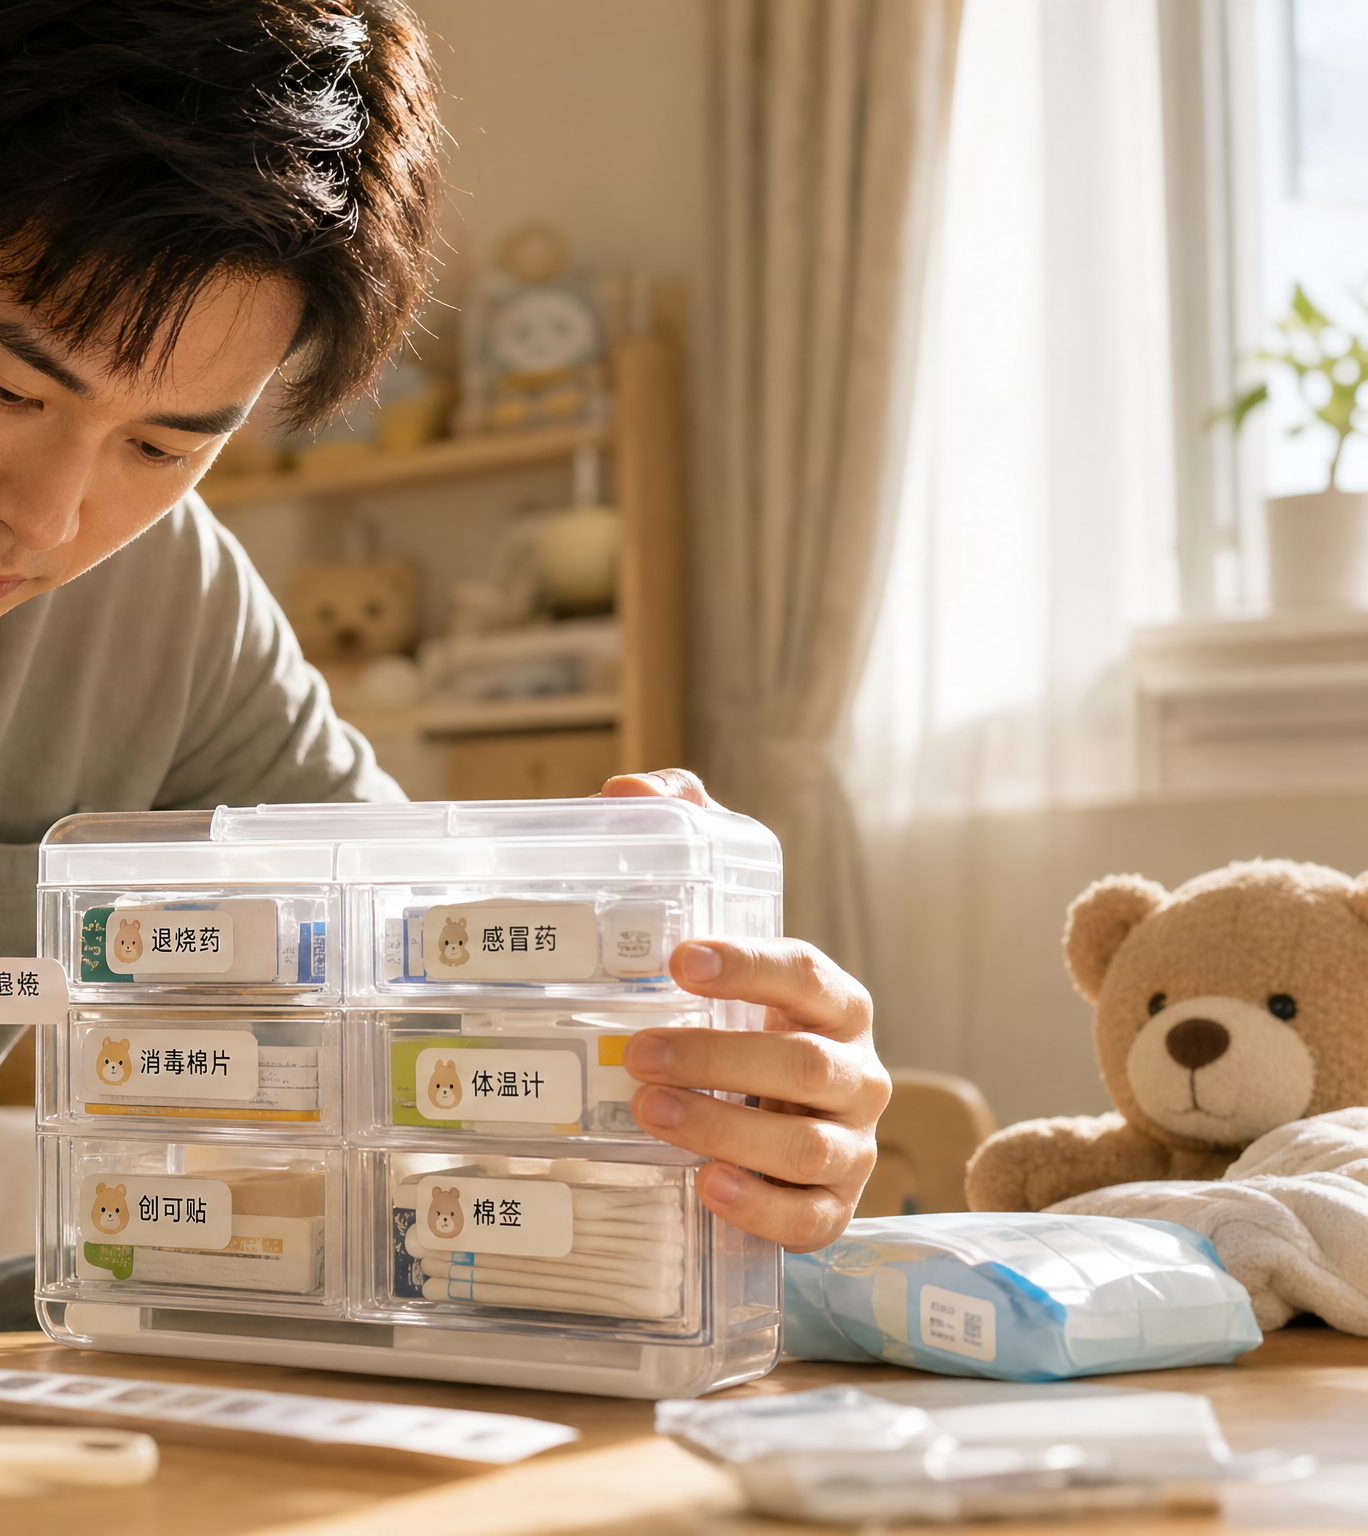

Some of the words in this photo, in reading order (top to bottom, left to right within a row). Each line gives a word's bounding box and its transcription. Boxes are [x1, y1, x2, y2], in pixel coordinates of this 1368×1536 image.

[152, 926, 220, 953] 退烧药
[482, 925, 557, 952] 感冒药
[140, 1048, 231, 1076] 消毒棉片
[471, 1070, 545, 1099] 体温计
[138, 1195, 207, 1224] 创可贴
[473, 1198, 522, 1227] 棉签
